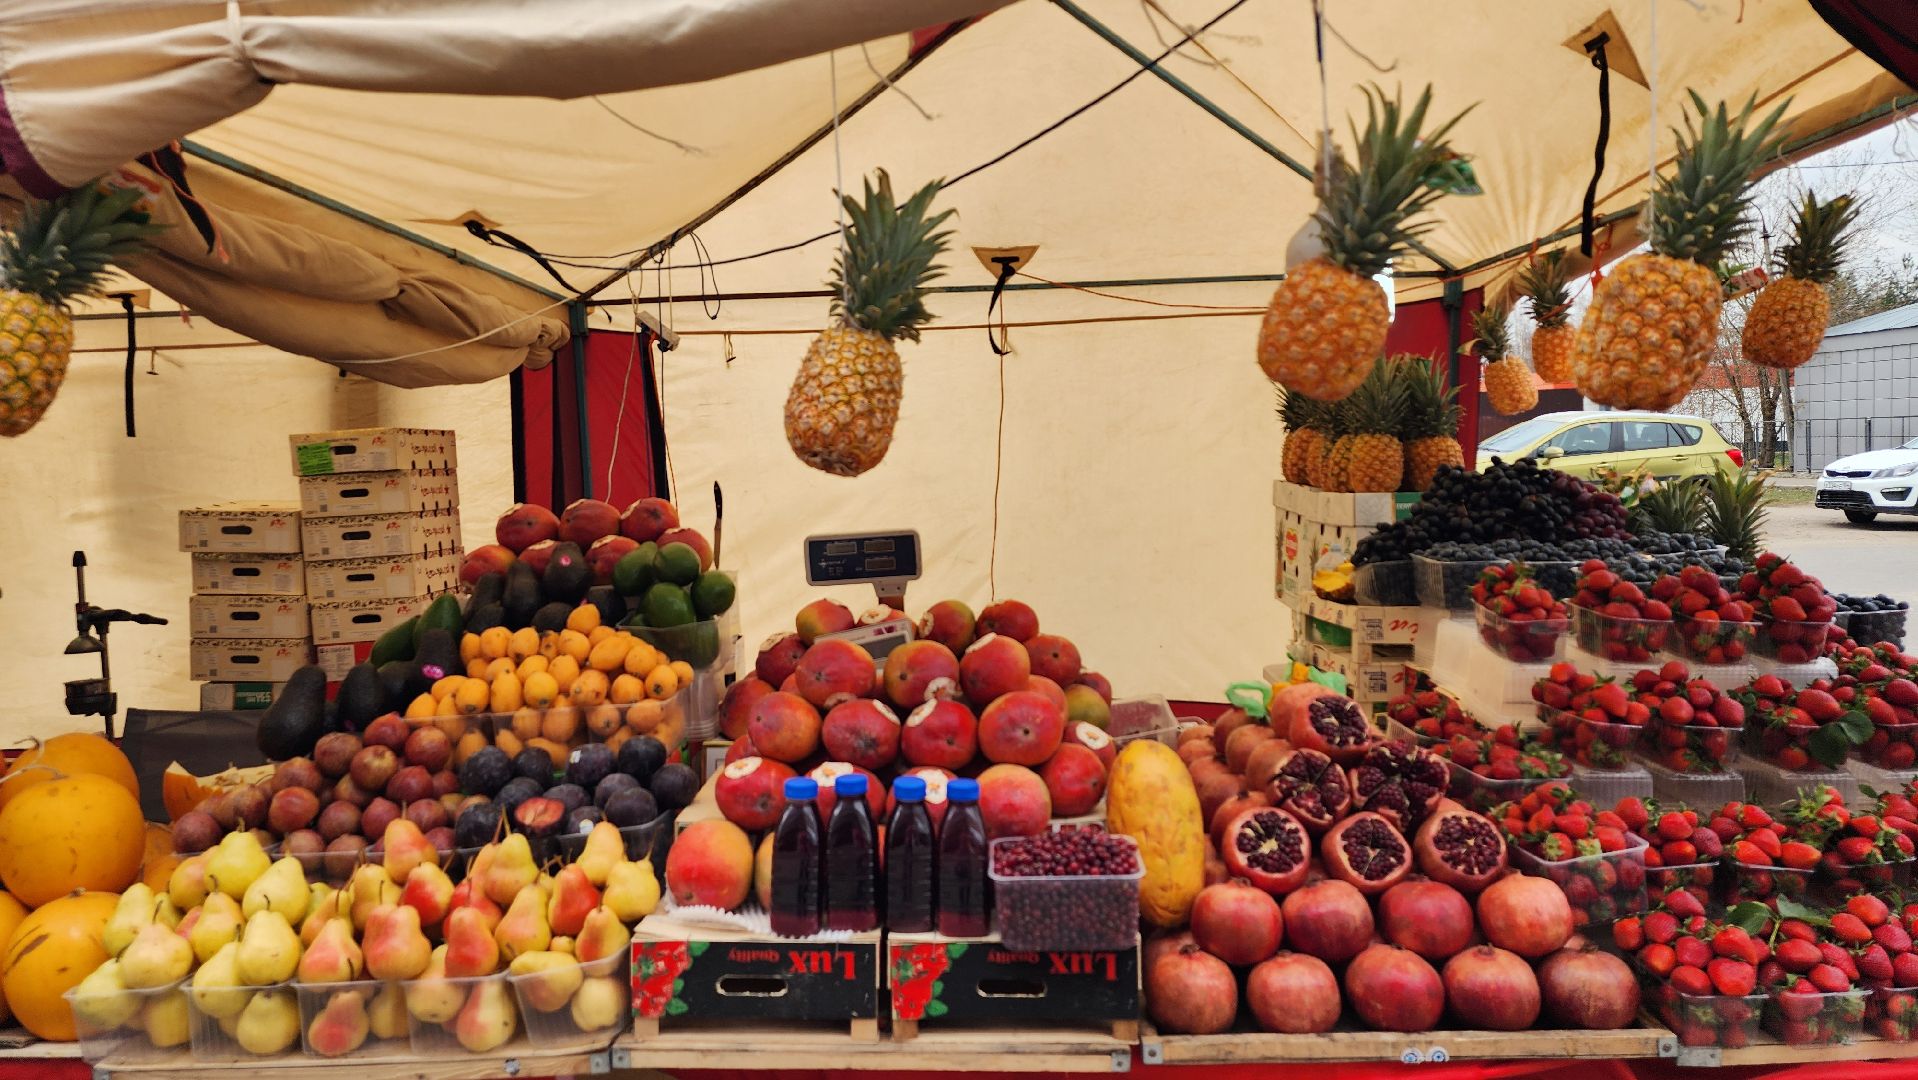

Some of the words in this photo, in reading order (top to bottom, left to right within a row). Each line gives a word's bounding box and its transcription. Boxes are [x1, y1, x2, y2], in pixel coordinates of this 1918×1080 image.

[727, 948, 780, 963] Quality
[788, 950, 857, 981] Lux
[987, 949, 1040, 964] Quality
[1049, 951, 1118, 982] Lux
